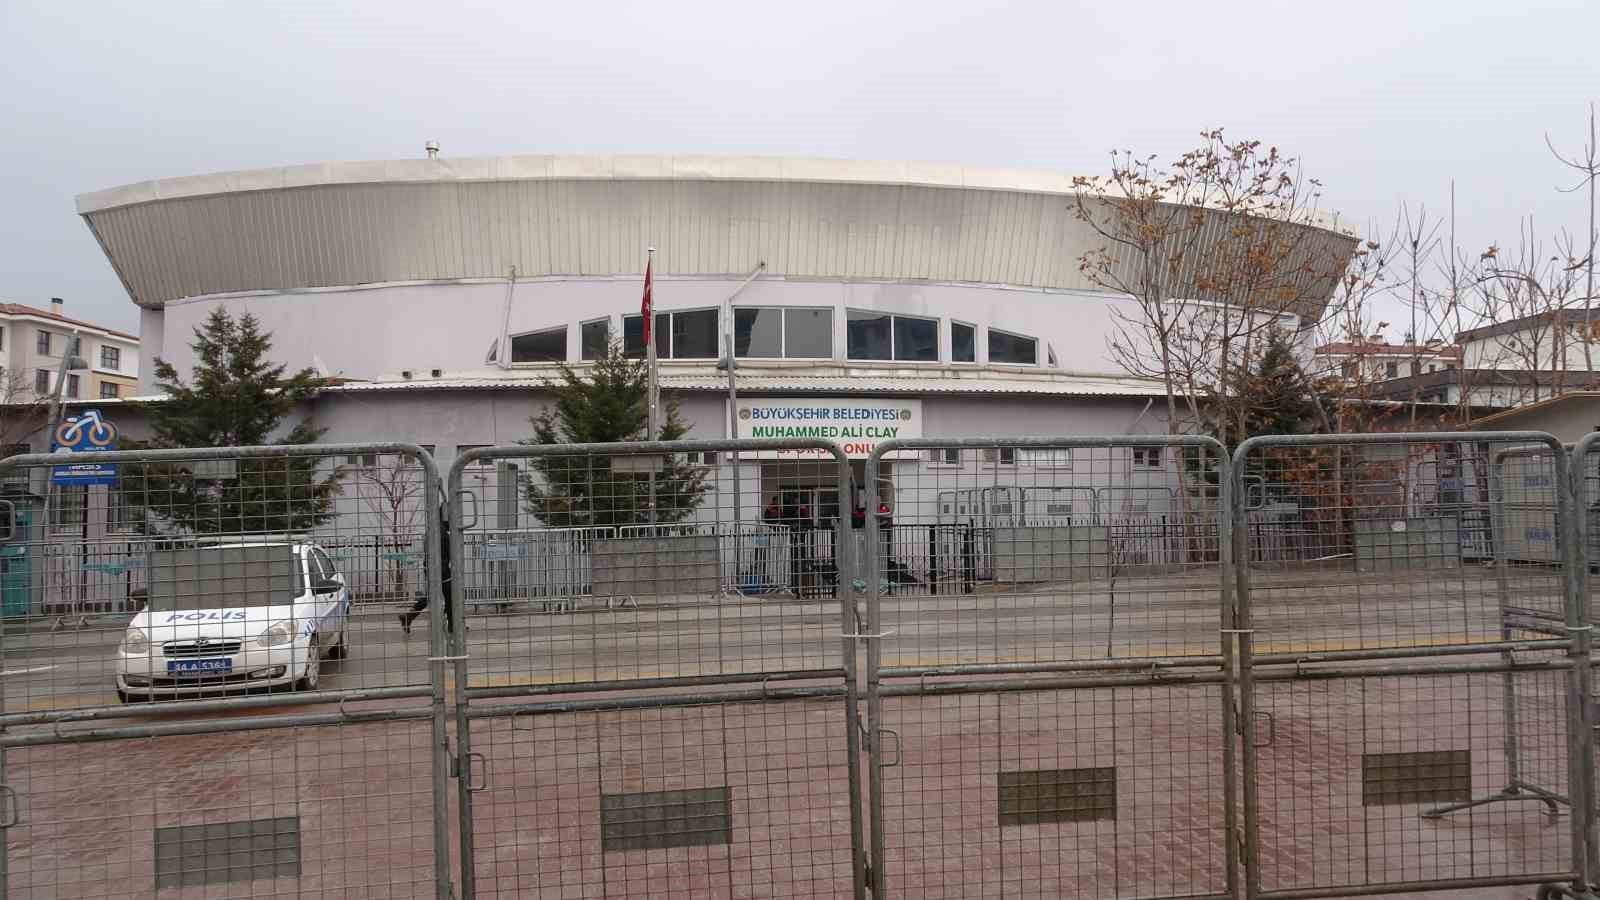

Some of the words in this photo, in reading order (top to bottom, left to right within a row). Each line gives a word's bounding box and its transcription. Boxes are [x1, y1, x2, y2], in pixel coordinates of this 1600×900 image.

[833, 408, 900, 421] BELEDİYESİ
[752, 426, 838, 438] MUHAMMED
[841, 424, 863, 438] ALİ
[865, 427, 898, 438] CLAY
